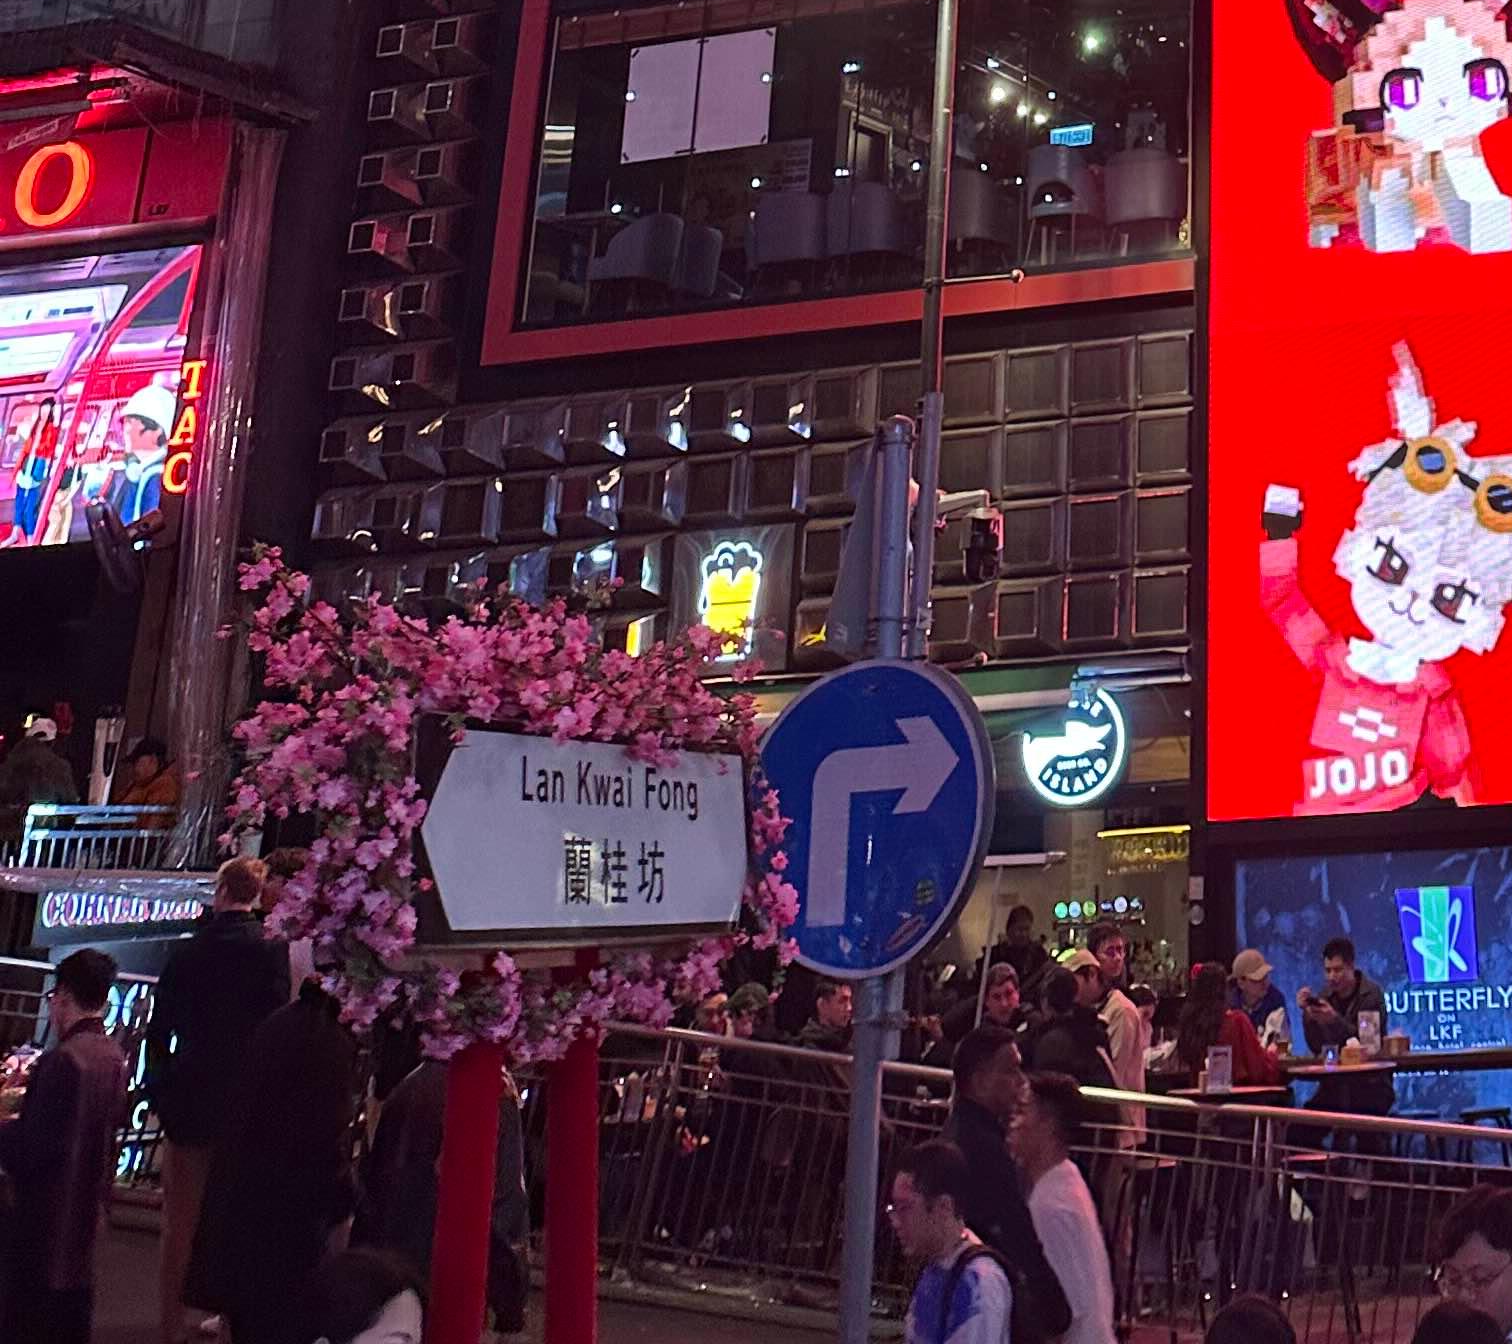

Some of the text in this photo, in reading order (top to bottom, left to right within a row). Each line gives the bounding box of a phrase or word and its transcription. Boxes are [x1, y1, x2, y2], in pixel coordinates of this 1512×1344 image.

[521, 755, 699, 821] Lan Kwai Fong
[1042, 757, 1108, 793] ISLAND
[1309, 749, 1409, 799] JOJO
[563, 835, 665, 905] 蘭桂坊
[1430, 1024, 1463, 1041] LKF
[1437, 1013, 1456, 1024] ON
